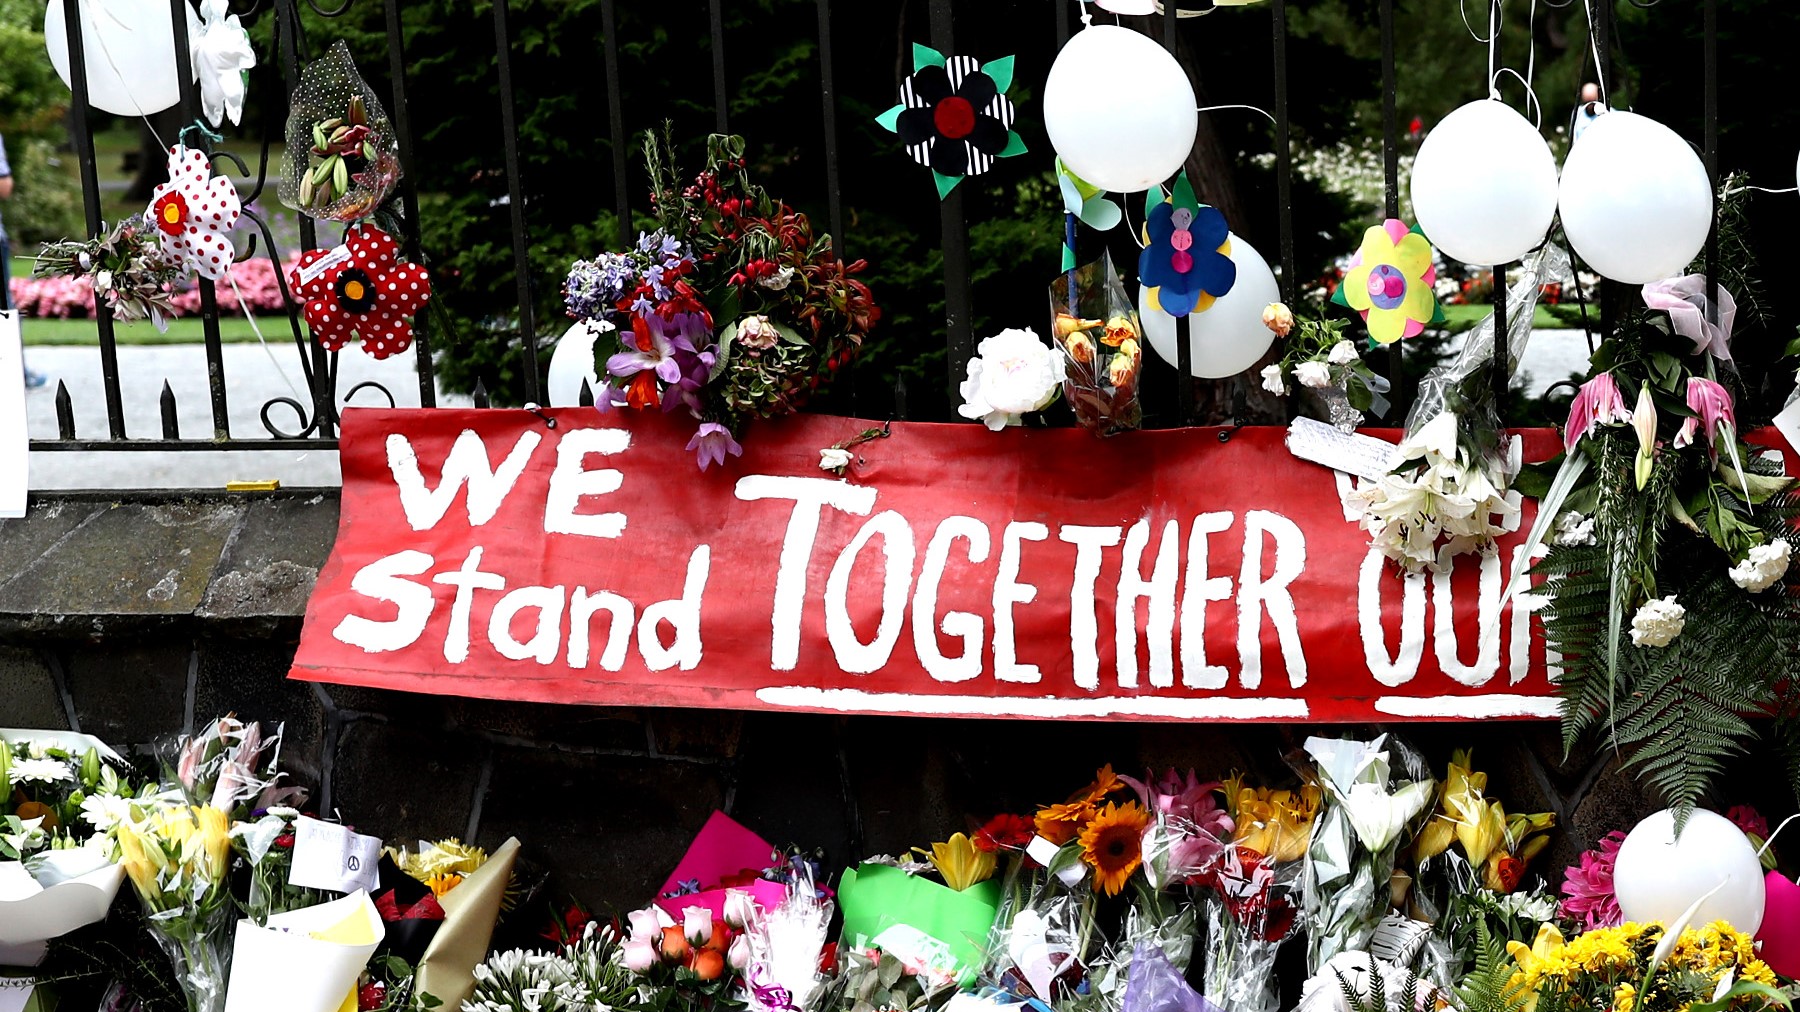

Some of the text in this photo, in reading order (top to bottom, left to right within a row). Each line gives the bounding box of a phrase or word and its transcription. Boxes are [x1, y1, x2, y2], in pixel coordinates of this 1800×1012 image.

[386, 427, 632, 539] WE
[332, 544, 712, 672] Stand
[733, 474, 1308, 691] TOGETHER
